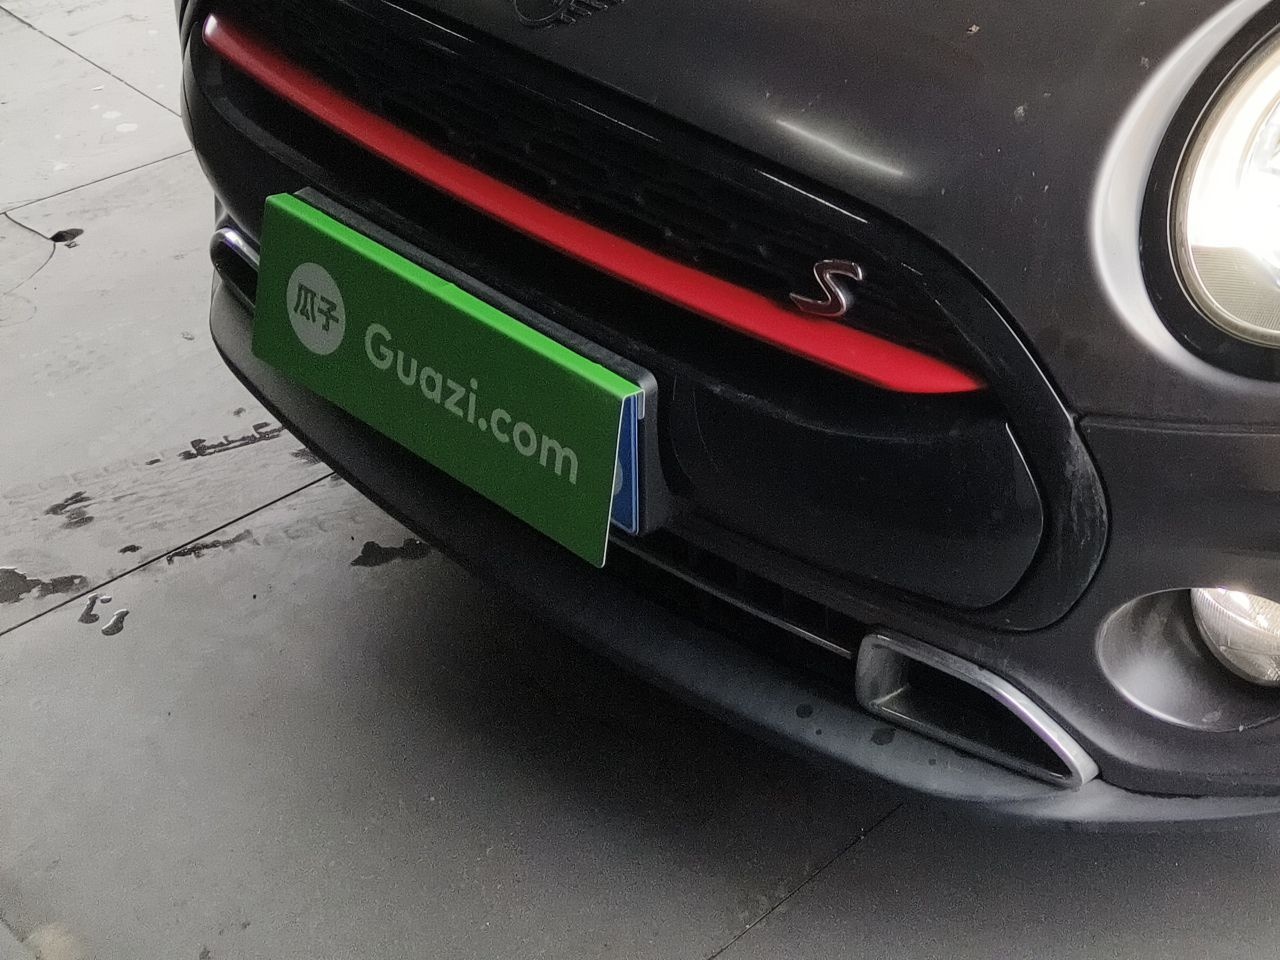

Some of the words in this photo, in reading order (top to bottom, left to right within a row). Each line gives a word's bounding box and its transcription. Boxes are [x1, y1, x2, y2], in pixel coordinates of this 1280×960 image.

[293, 283, 340, 332] 瓜子
[789, 259, 862, 317] S
[364, 322, 579, 486] Guazi.com
